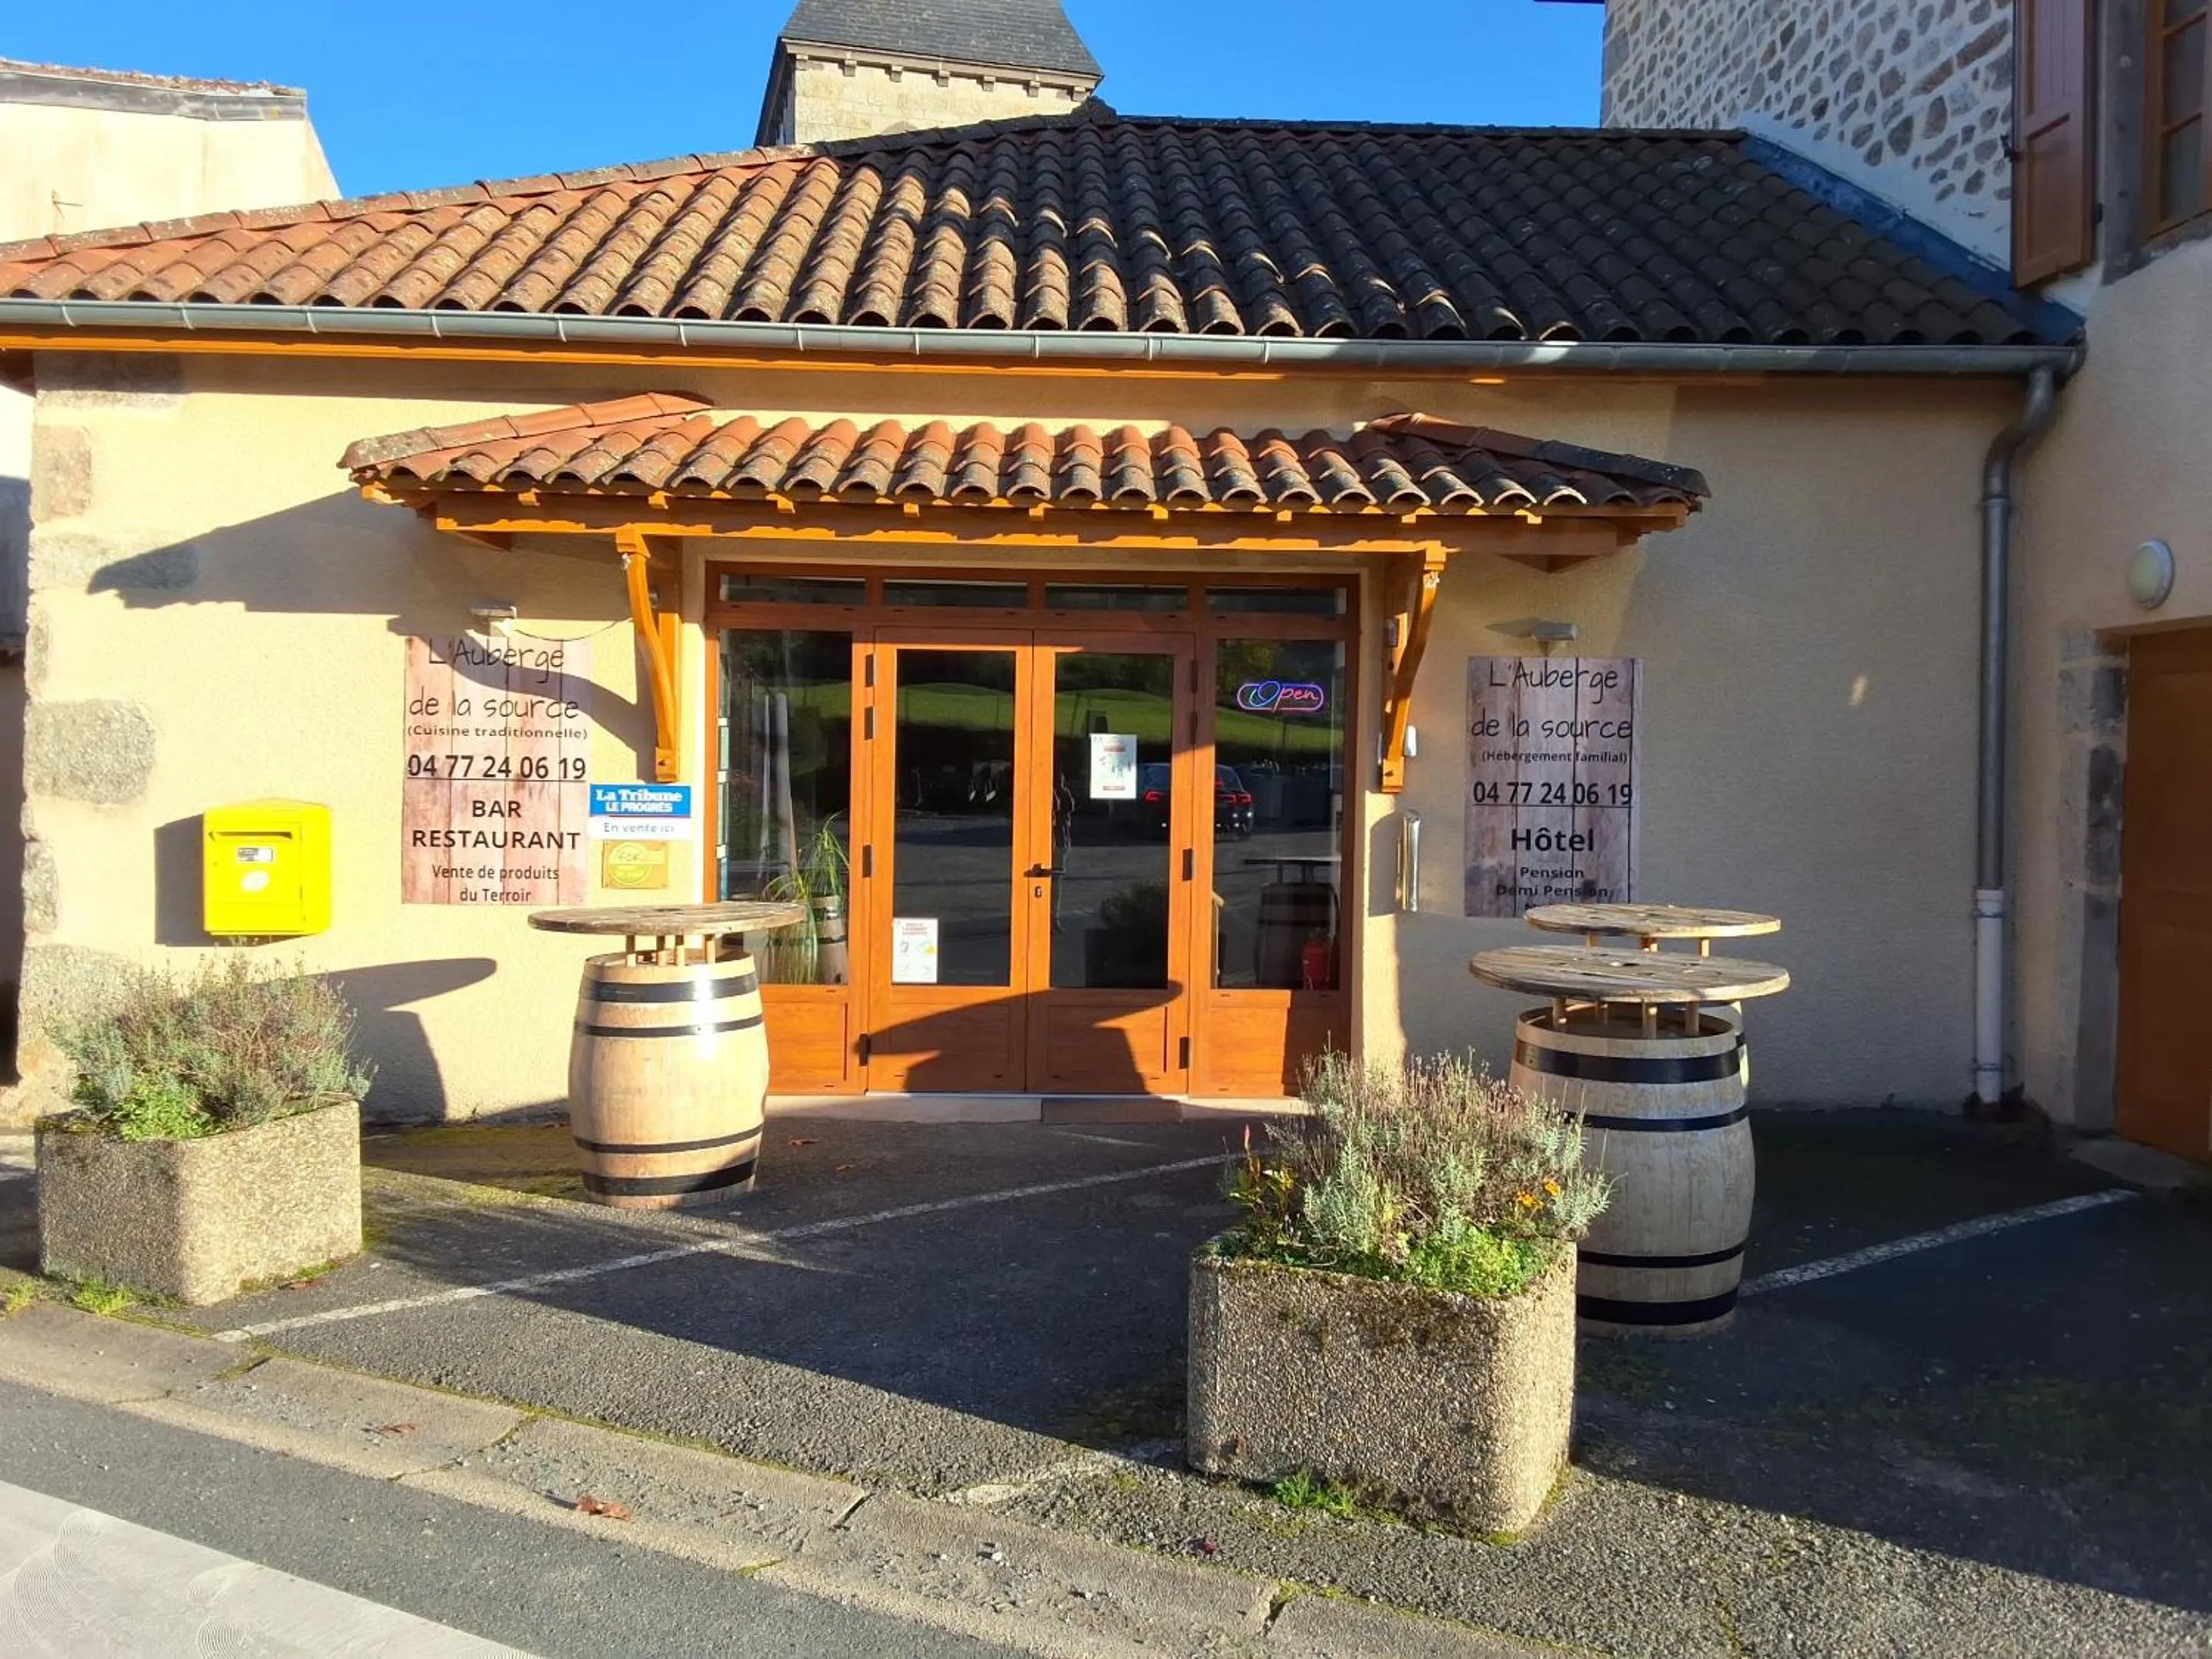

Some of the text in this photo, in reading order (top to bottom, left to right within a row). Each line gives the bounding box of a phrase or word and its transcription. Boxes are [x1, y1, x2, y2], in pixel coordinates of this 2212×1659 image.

[428, 637, 564, 683] L'Auberge
[1490, 659, 1618, 704] L'Auberge
[409, 686, 580, 719] de la source
[1249, 679, 1319, 712] Open
[408, 725, 588, 740] (Cuisine traditionnelle)
[1471, 708, 1633, 739] de la source
[407, 755, 587, 780] 04 77 24 06 19
[1576, 750, 1628, 765] familial)
[595, 788, 683, 802] La Tribune
[1473, 782, 1632, 805] 04 77 24 06 19
[471, 800, 522, 818] BAR
[605, 801, 620, 812] LE
[603, 822, 619, 833] En
[622, 822, 656, 834] vente
[412, 830, 580, 850] RESTAURANT
[1511, 827, 1595, 851] Hôtel
[431, 864, 559, 884] Vente de produits
[1520, 867, 1584, 878] Pension
[460, 887, 531, 903] du Terroir
[1496, 884, 1538, 897] Demi
